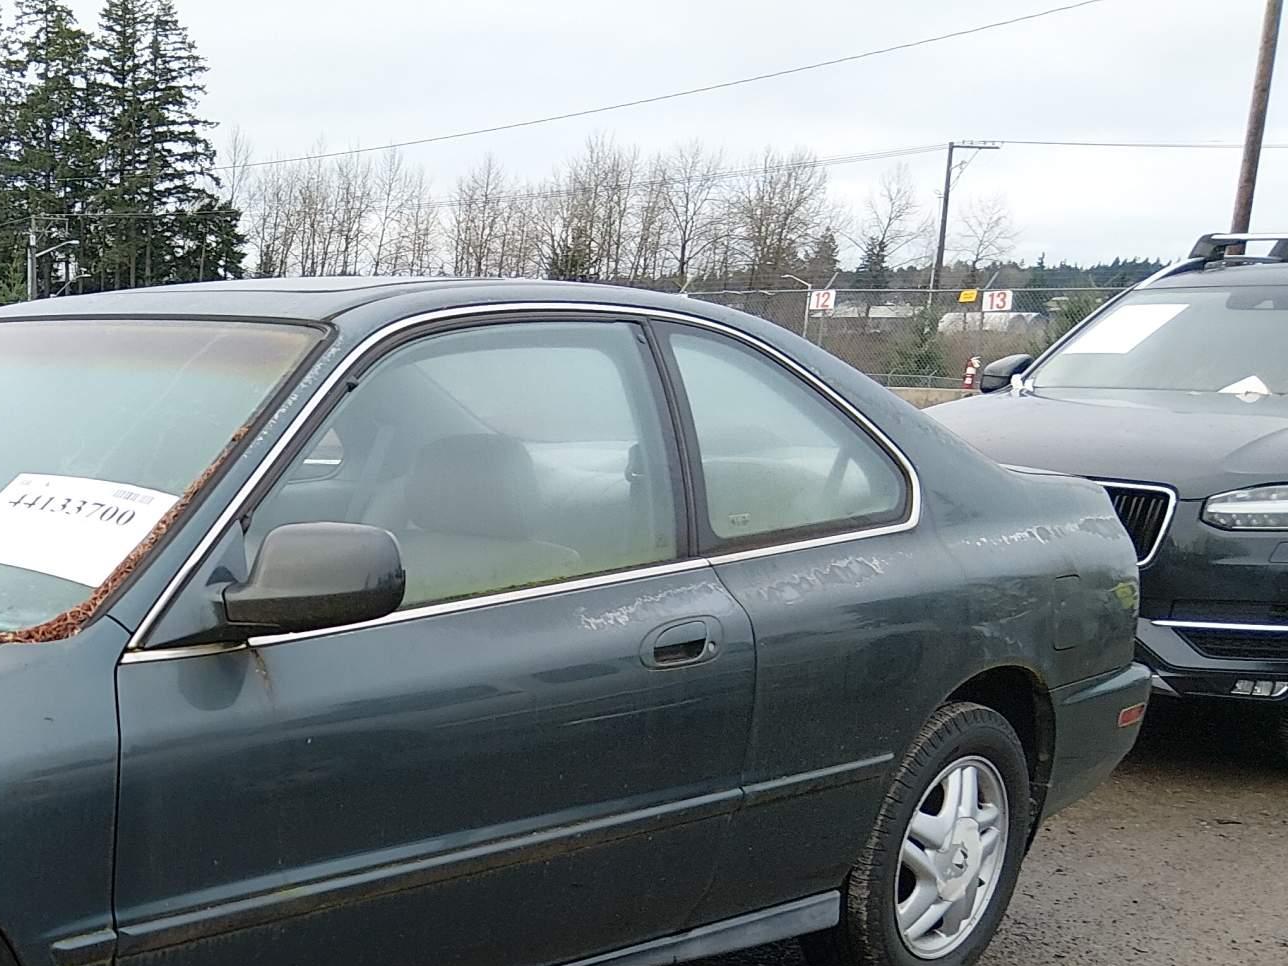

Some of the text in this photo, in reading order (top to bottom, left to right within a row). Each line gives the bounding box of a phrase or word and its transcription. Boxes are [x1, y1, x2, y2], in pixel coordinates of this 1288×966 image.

[815, 292, 831, 308] 12
[988, 292, 1007, 309] 13
[8, 493, 136, 526] 44133700
